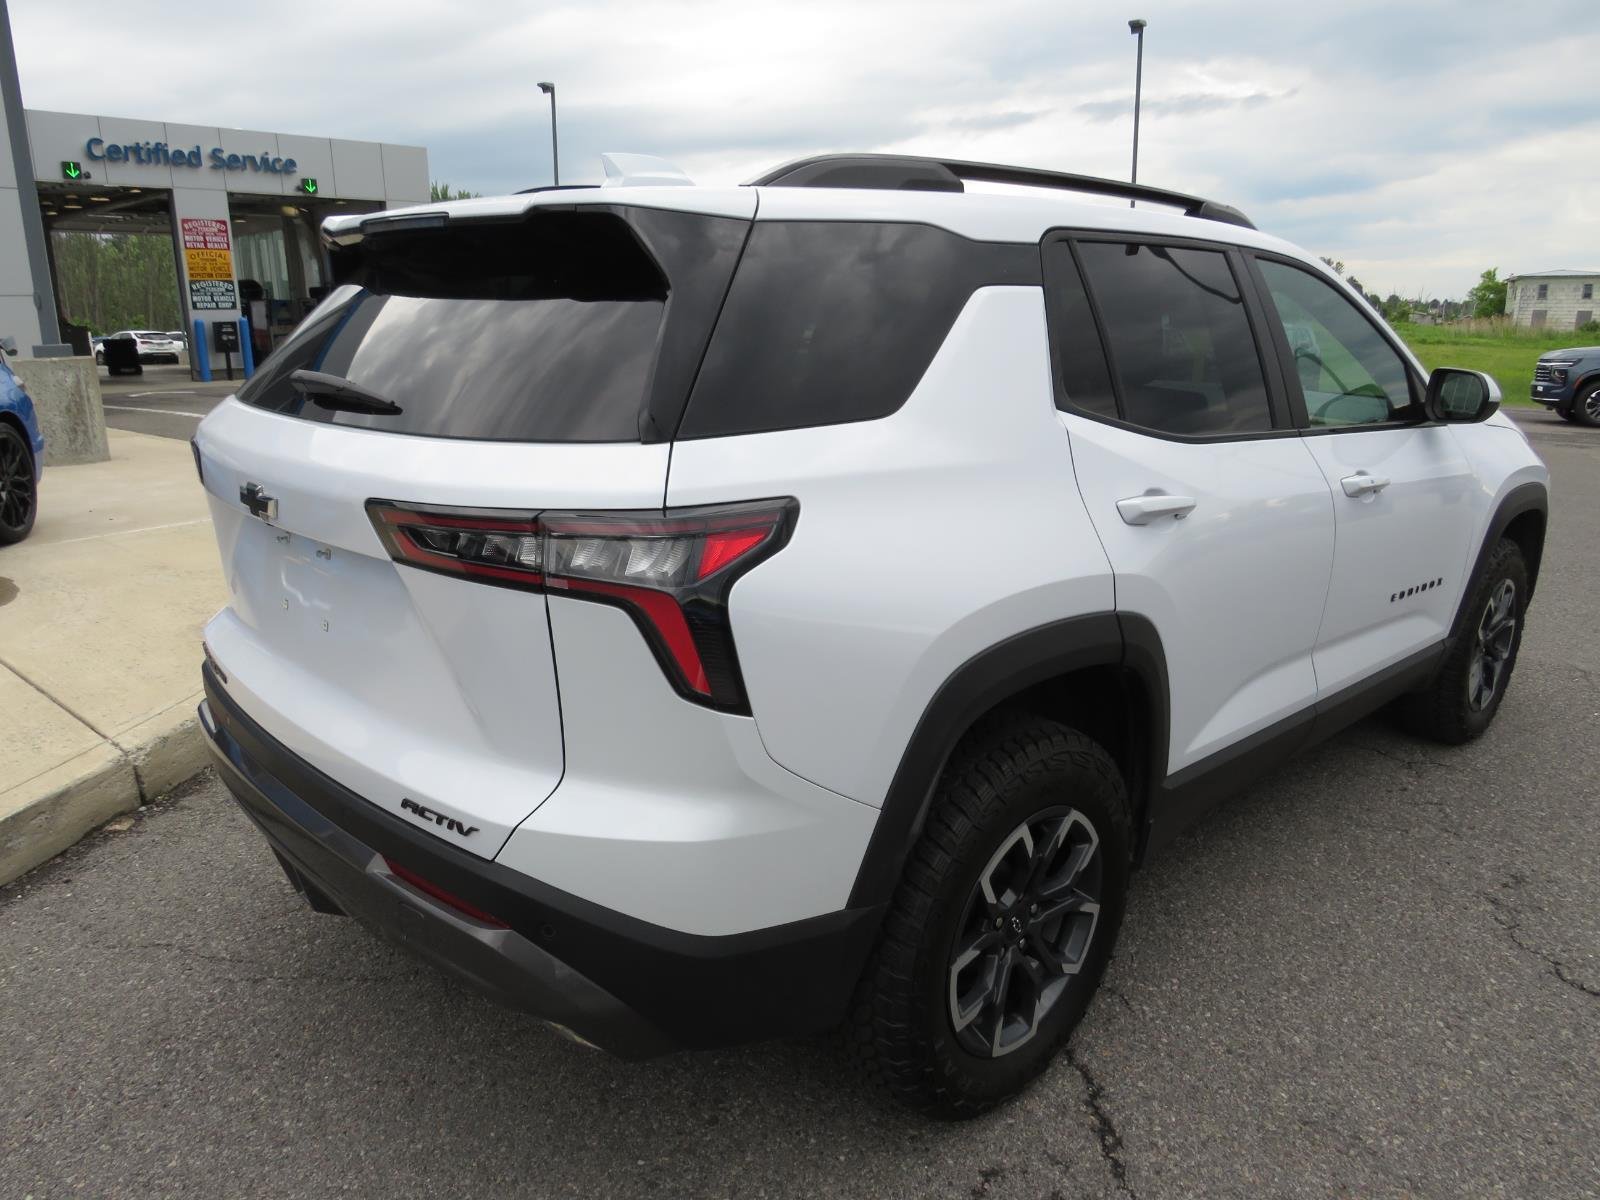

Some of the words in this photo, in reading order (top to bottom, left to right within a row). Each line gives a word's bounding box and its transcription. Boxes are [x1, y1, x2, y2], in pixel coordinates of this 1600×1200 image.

[86, 137, 202, 169] Certified
[209, 147, 297, 175] Service
[184, 220, 226, 231] REGISTERED
[190, 251, 226, 259] OFFICIAL
[192, 281, 233, 290] REGISTERED
[401, 798, 480, 836] ACTIV
